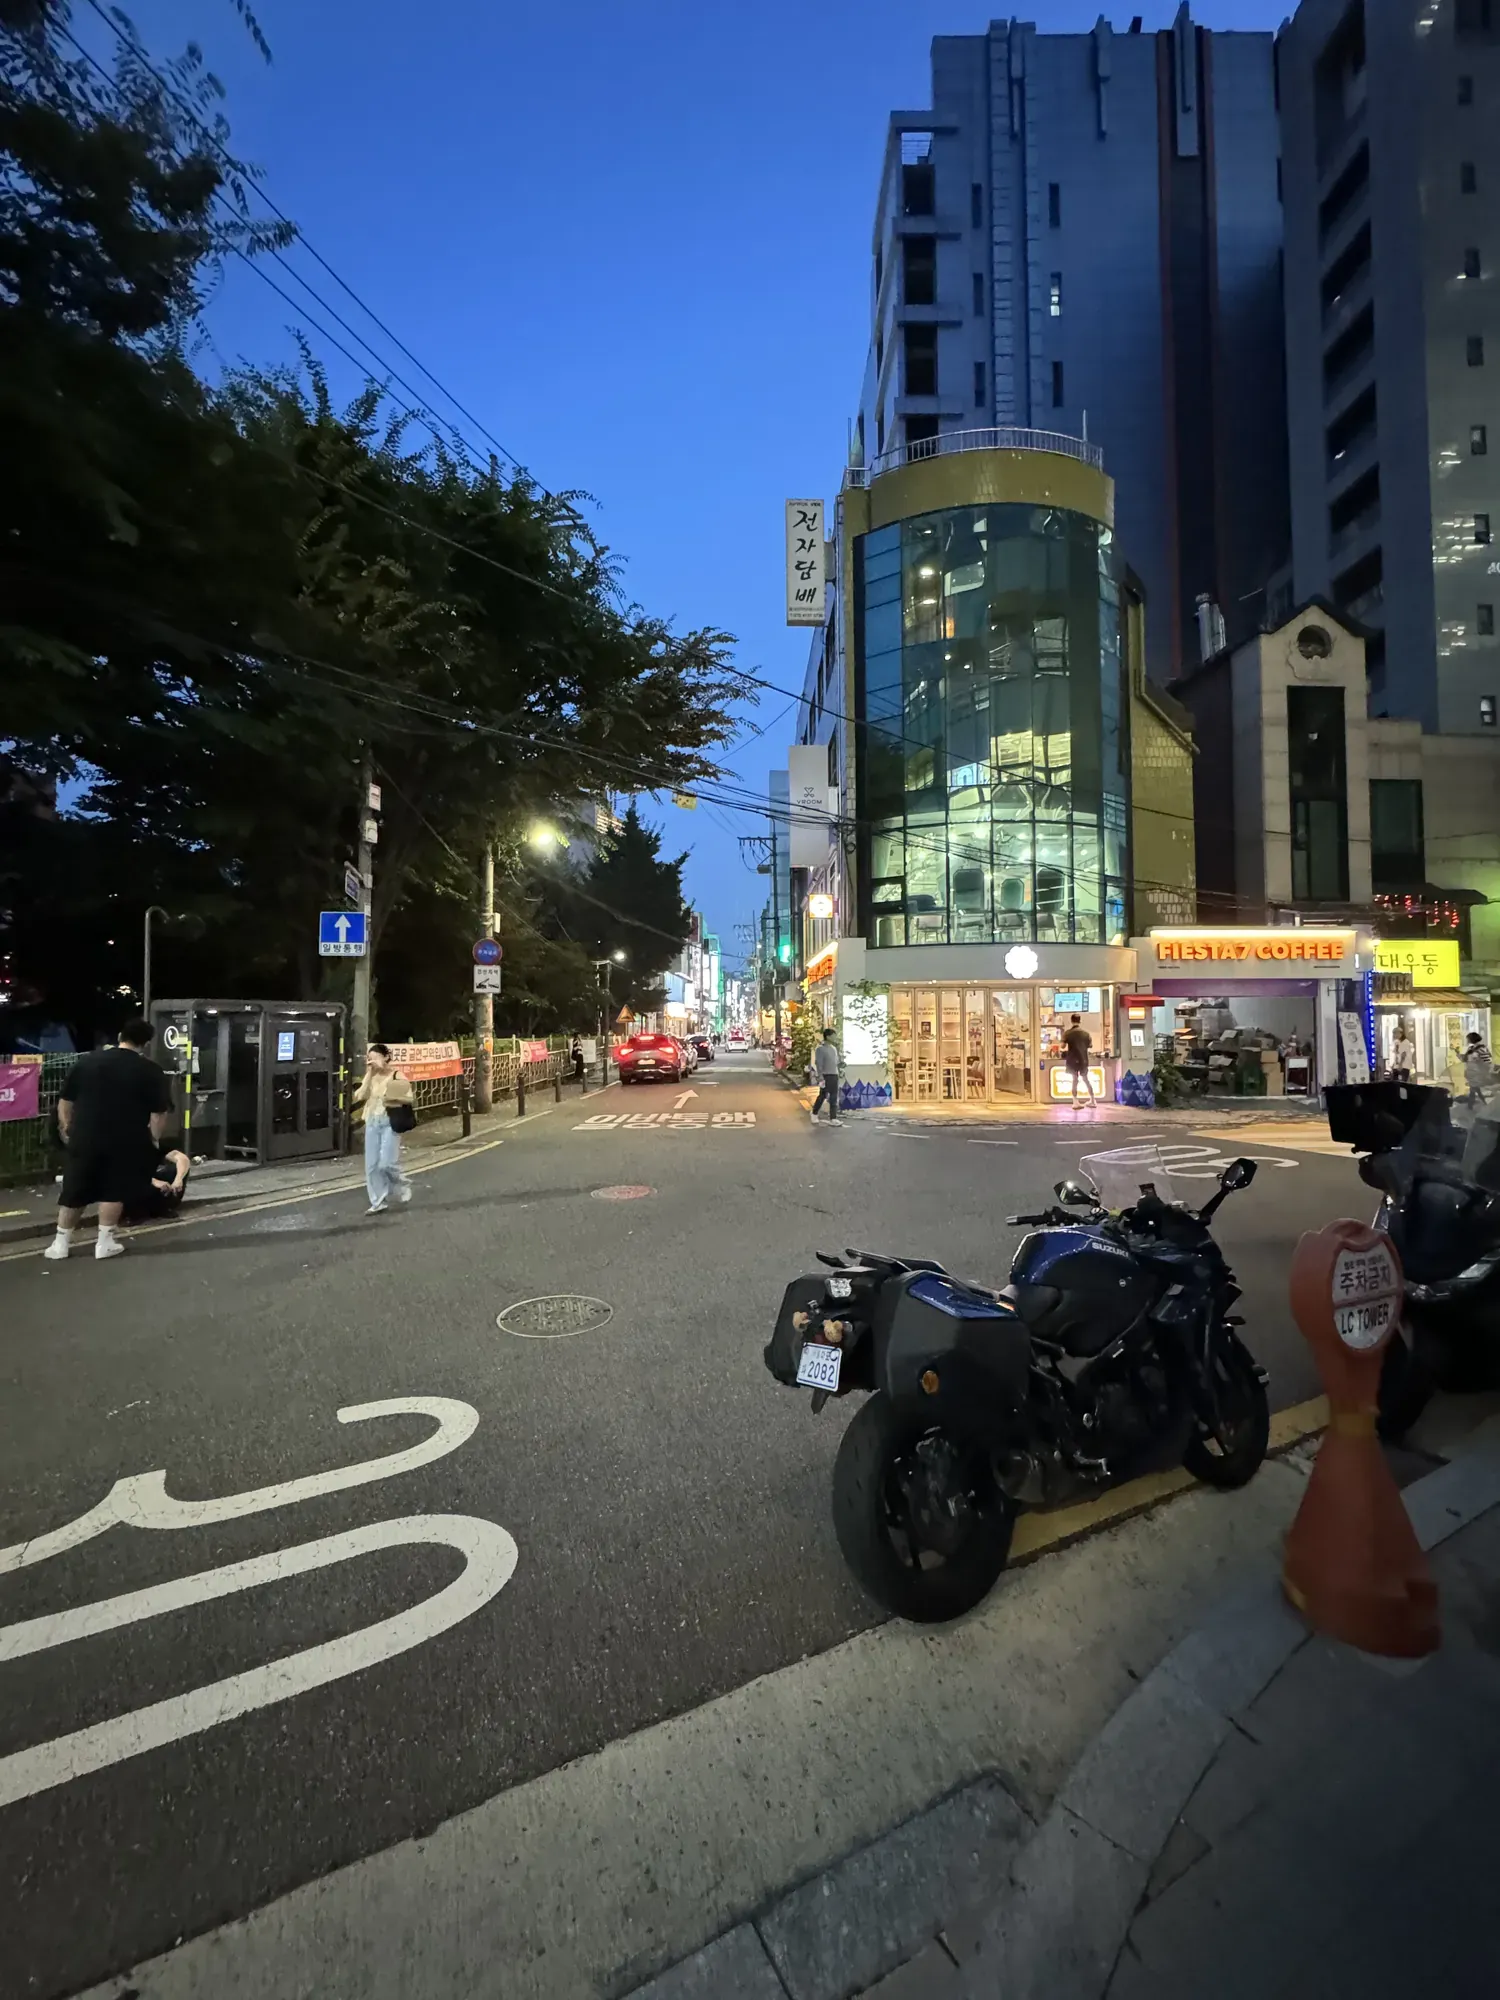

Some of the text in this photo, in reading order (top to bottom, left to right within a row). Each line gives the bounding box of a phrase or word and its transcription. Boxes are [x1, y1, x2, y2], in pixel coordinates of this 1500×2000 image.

[793, 510, 818, 603] 전자담배
[322, 943, 363, 953] 일방통행
[1158, 941, 1344, 960] FIESTA7 COFFEE
[1378, 953, 1439, 975] 대우동
[409, 1046, 454, 1061] 금연구역입니다
[571, 1111, 757, 1131] 일방통행
[1092, 1242, 1129, 1258] SUZUKI
[1340, 1264, 1391, 1296] 주차금지
[1341, 1303, 1390, 1335] LC TOWER
[808, 1361, 835, 1383] 2082
